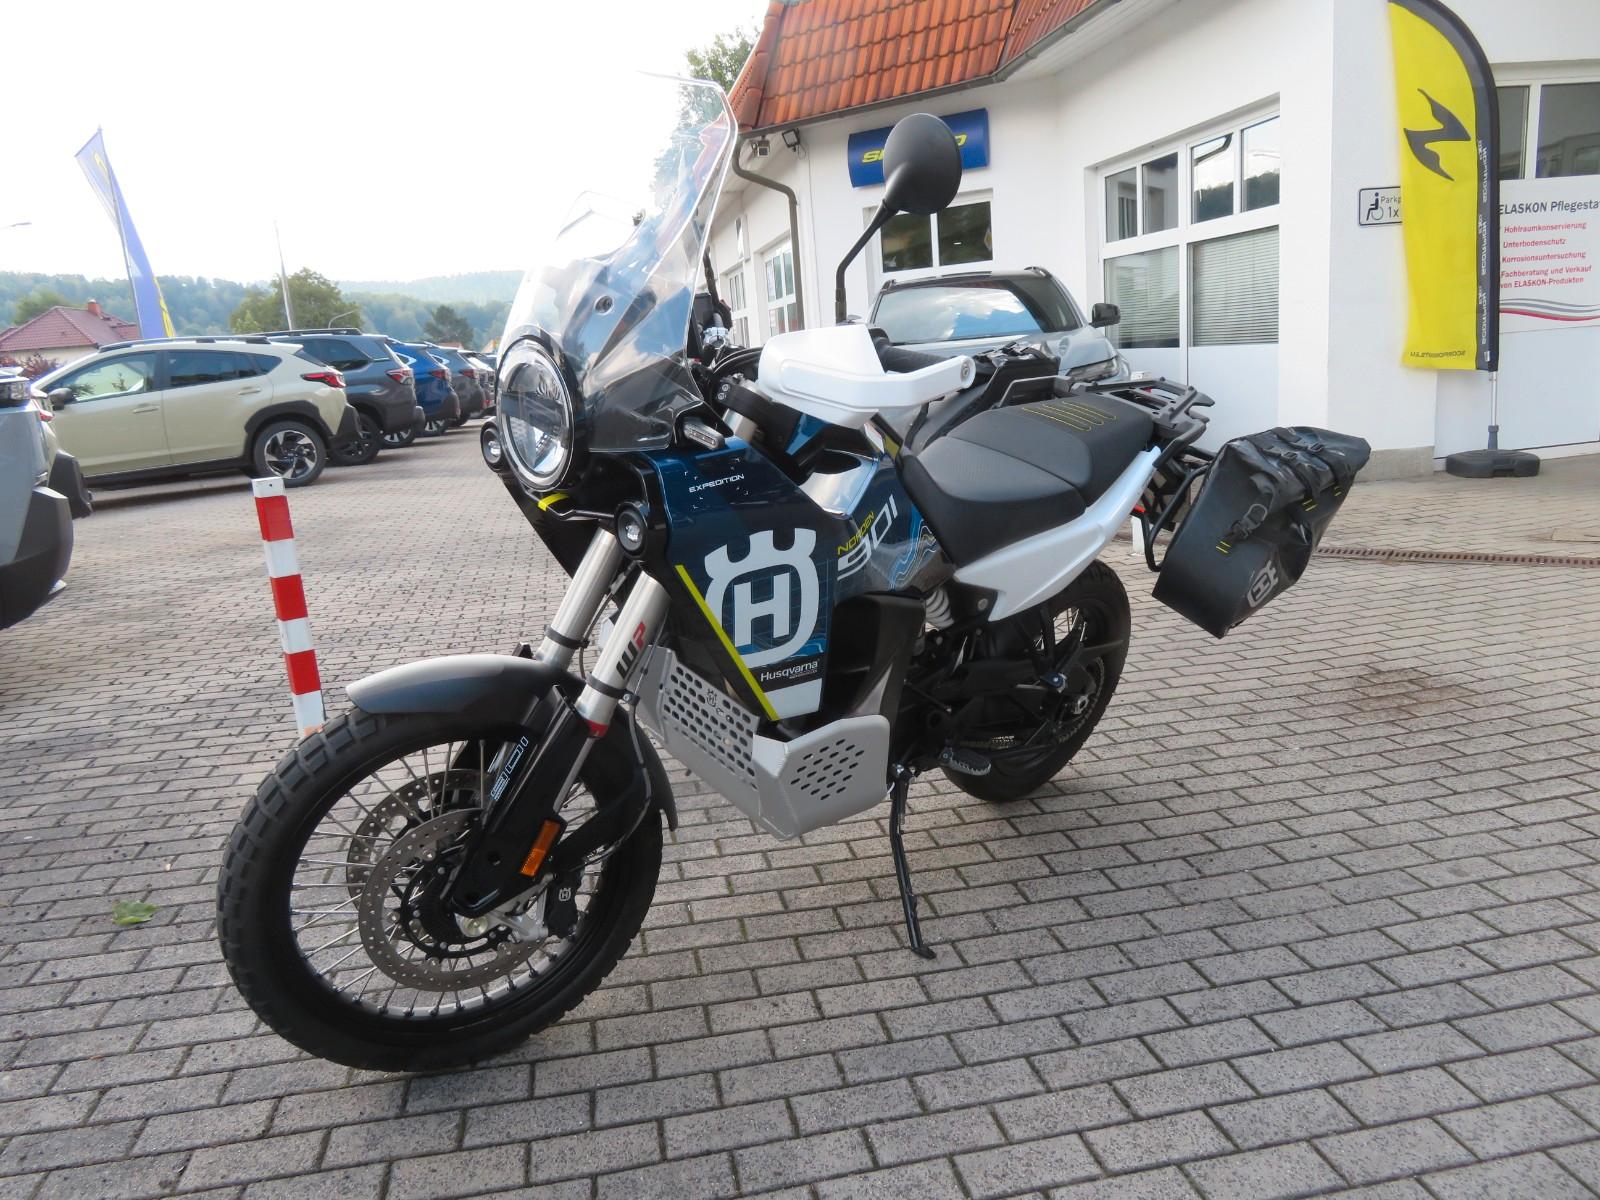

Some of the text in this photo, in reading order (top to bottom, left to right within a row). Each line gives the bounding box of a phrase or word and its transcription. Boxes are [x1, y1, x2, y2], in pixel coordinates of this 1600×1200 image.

[1389, 207, 1399, 218] 1x
[1499, 200, 1600, 215] ELASKON Pflegesta
[1504, 222, 1587, 233] Hohlraumkonservierung
[1503, 238, 1567, 248] Unterbodenschutz
[1502, 251, 1586, 263] Korrosionsuntersuchung
[1500, 265, 1592, 278] Fachberatung und Verkauf
[1514, 277, 1584, 288] ELASKON-Produkten
[689, 473, 745, 493] EXPEDITION
[836, 493, 898, 581] 901
[837, 511, 875, 556] NORDEN
[760, 660, 818, 682] Husqvarna
